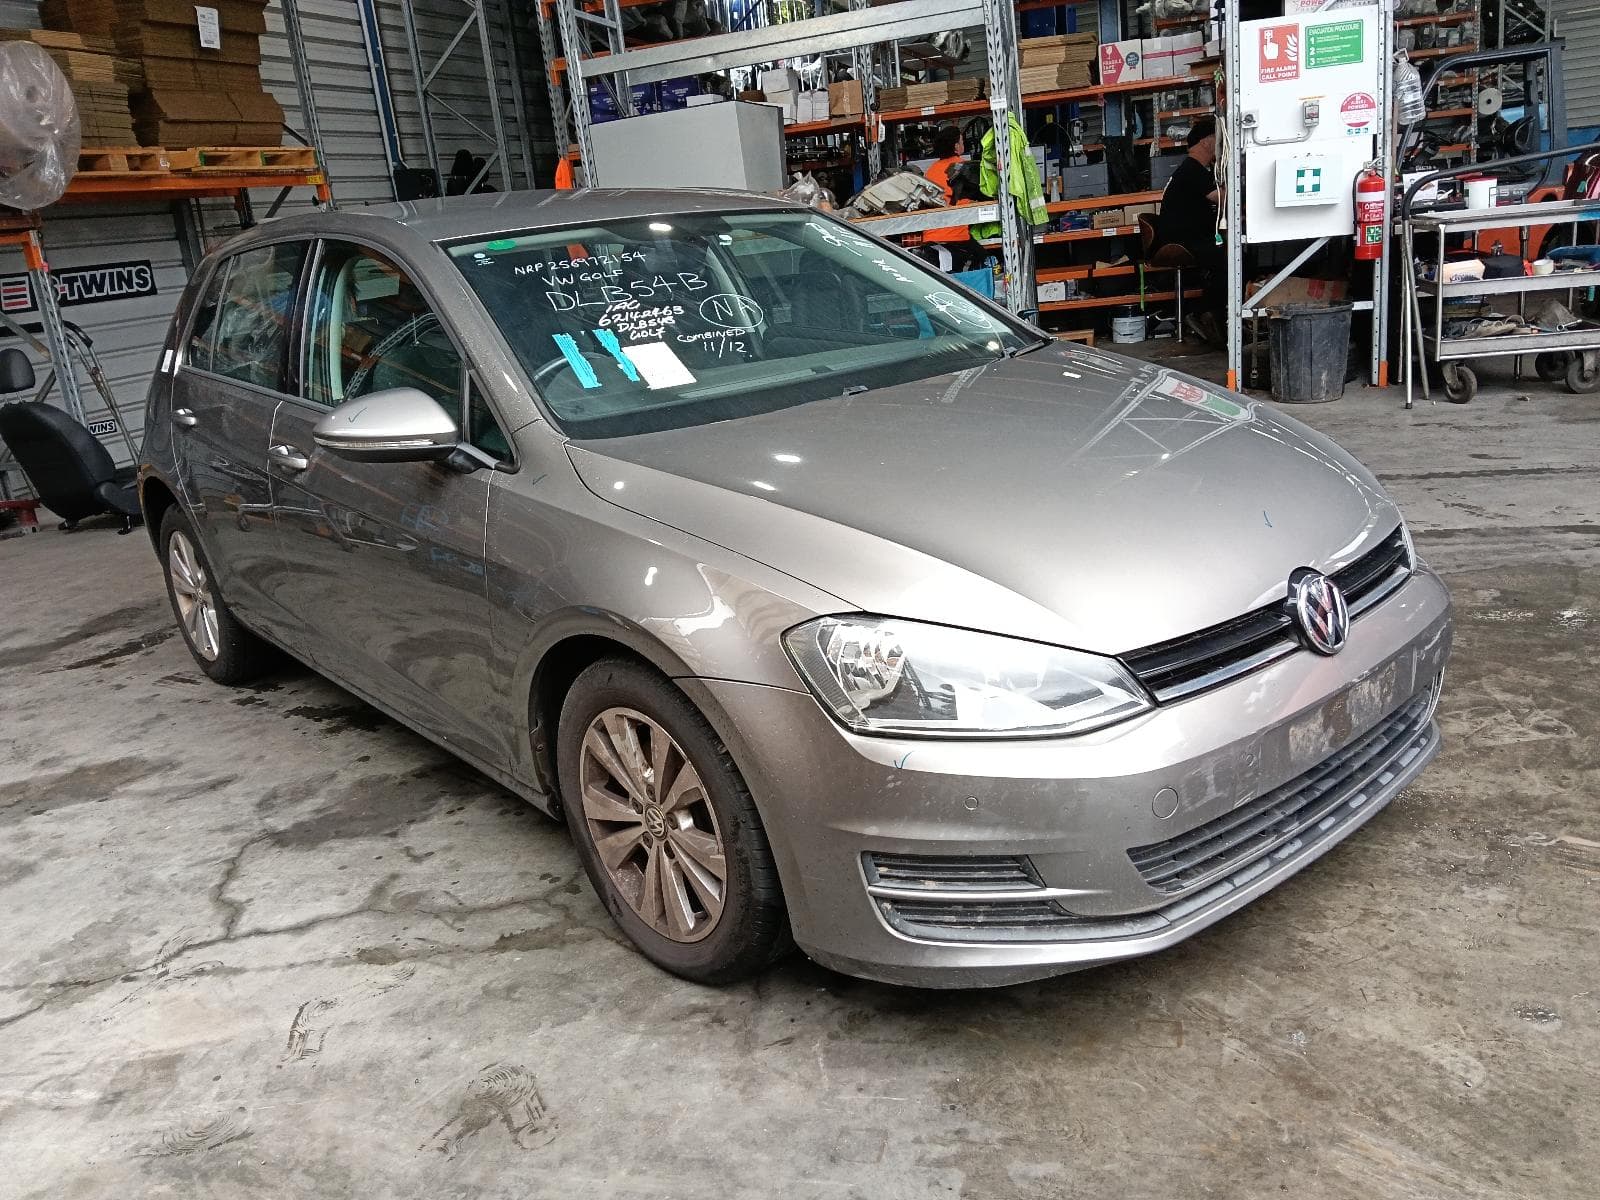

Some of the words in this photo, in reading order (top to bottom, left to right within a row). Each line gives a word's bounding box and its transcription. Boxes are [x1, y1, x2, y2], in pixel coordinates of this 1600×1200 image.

[1309, 26, 1334, 36] EVACUATION
[1310, 36, 1315, 45] 1
[1309, 47, 1316, 56] 2
[1276, 64, 1297, 72] ALARM
[1310, 57, 1316, 66] 3
[514, 262, 543, 275] NRP
[541, 273, 574, 287] VW
[579, 269, 624, 282] GOLF
[545, 272, 708, 312] DLB54B
[712, 297, 756, 321] NA
[629, 326, 666, 341] GOLF
[676, 328, 746, 343] COMBINED
